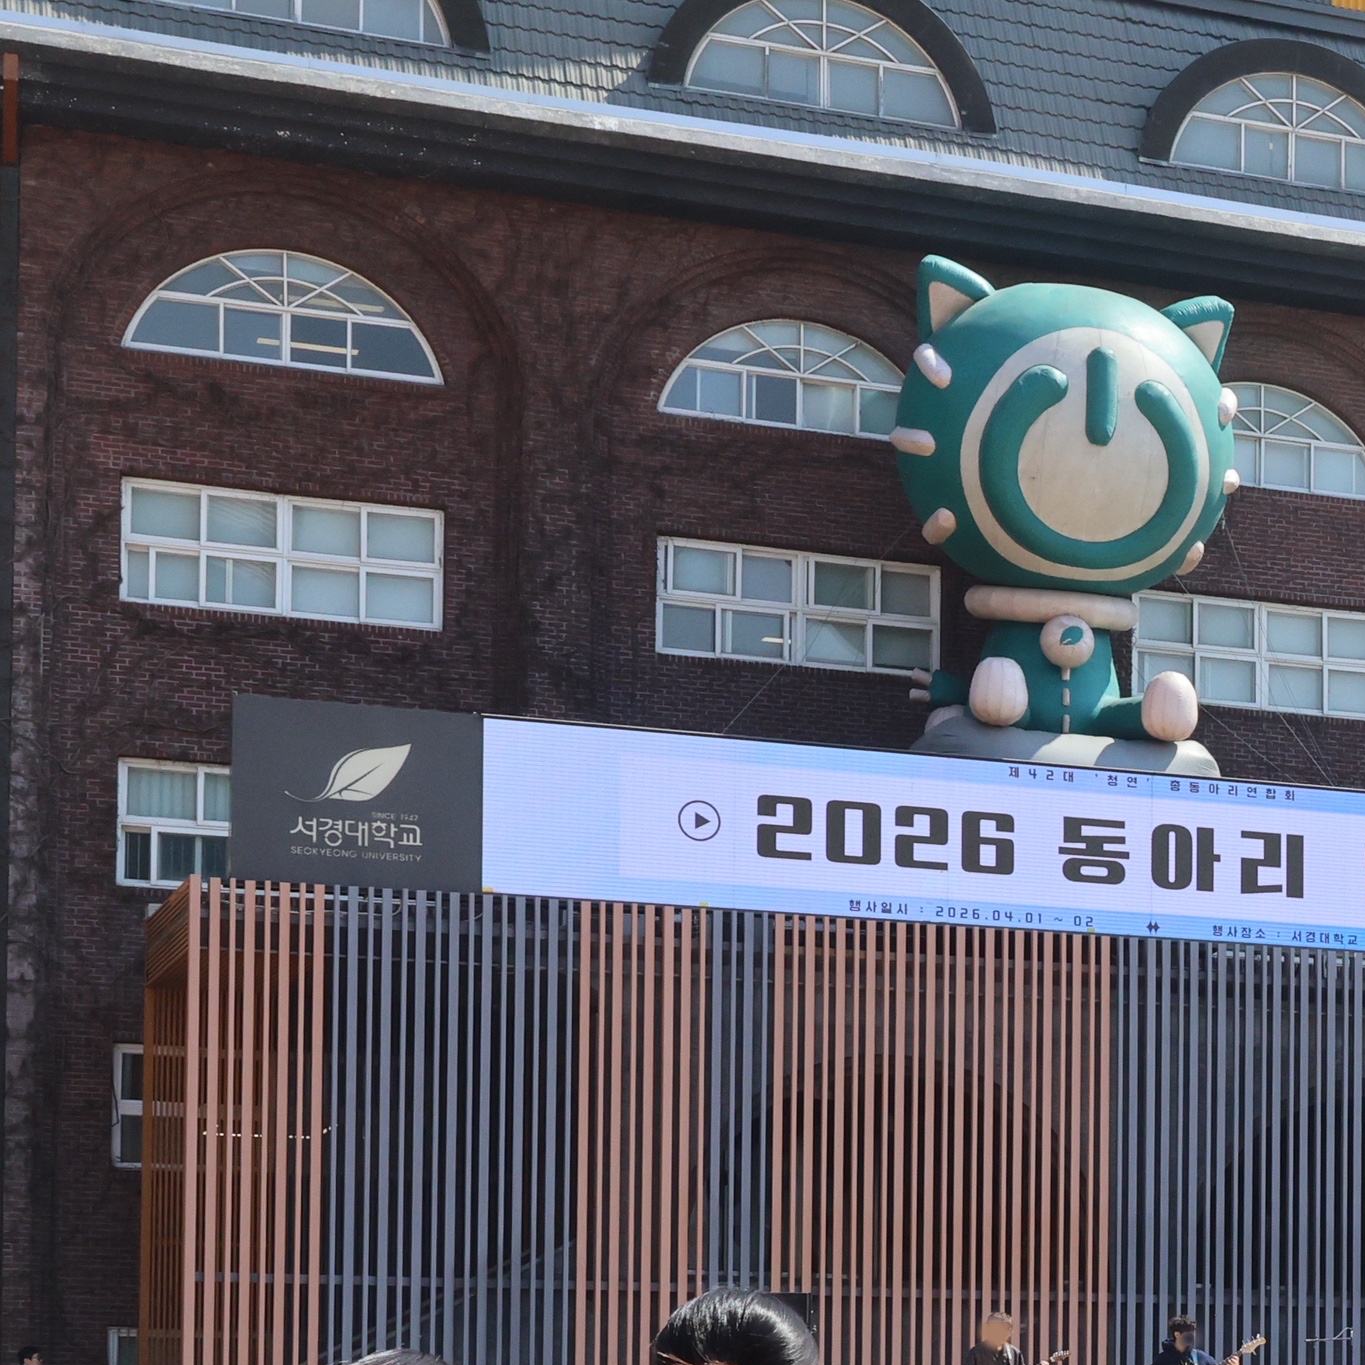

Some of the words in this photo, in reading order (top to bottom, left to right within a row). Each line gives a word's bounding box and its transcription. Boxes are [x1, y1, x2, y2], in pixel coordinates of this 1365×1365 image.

[289, 816, 424, 849] 서경대학교
[757, 794, 1015, 875] 2026
[1058, 815, 1304, 899] 동아리
[290, 845, 357, 858] SEOKYEONG
[361, 851, 422, 862] UNIVERSITY
[849, 899, 908, 915] 행사일시
[936, 906, 1042, 924] 2026.04.01
[1073, 915, 1094, 927] 02
[1212, 924, 1267, 939] 행사장소
[1292, 930, 1359, 946] 서경대학교
